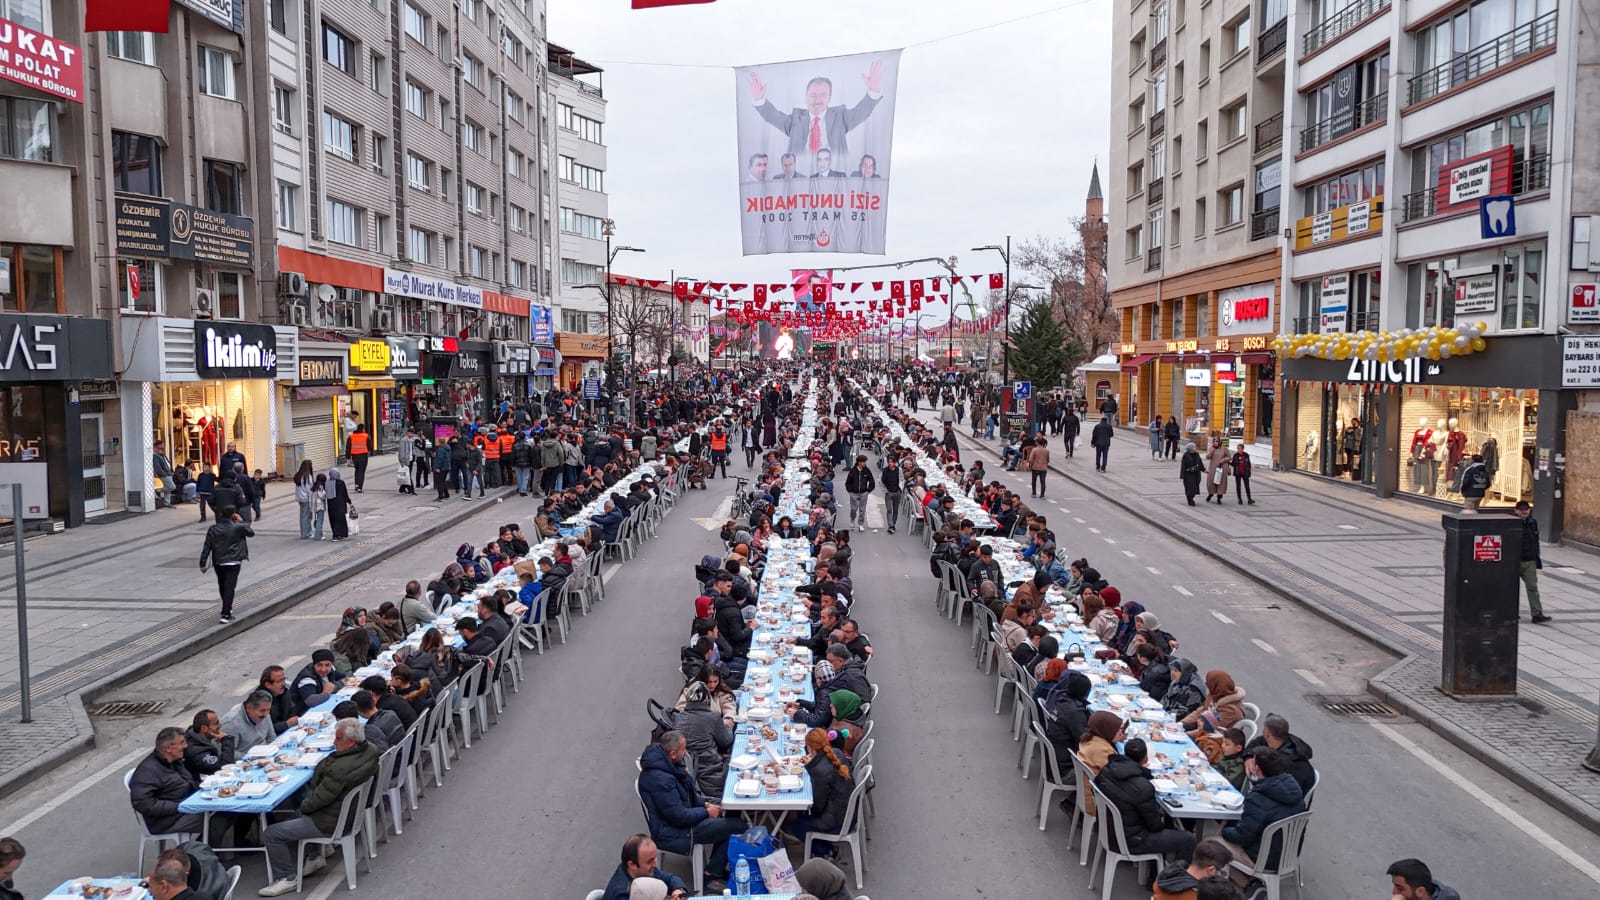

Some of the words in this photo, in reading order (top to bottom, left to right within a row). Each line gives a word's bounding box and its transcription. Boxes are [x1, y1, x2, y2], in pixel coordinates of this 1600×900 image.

[15, 53, 61, 80] POLAT
[6, 67, 40, 86] HUKUK
[42, 79, 77, 98] BÜROSU
[122, 203, 161, 218] ÖZDEMİR
[193, 210, 226, 225] ÖZDEMİR
[117, 217, 151, 228] AVUKATLIK
[193, 221, 219, 232] HUKUK
[221, 225, 250, 239] BÜROSU
[117, 229, 158, 240] DANIŞMANLIK
[118, 241, 165, 252] ARABULUCULUK
[411, 276, 435, 297] Murat
[438, 282, 454, 300] Kurs
[457, 286, 481, 305] Merkezi
[1235, 297, 1269, 320] BOSCH
[1243, 336, 1265, 350] BOSCH
[1568, 340, 1580, 350] DİŞ
[262, 348, 277, 371] life
[363, 344, 385, 360] EYFEL
[1564, 353, 1594, 361] BAYBARS
[458, 353, 478, 372] Tokuş
[1014, 381, 1022, 394] P
